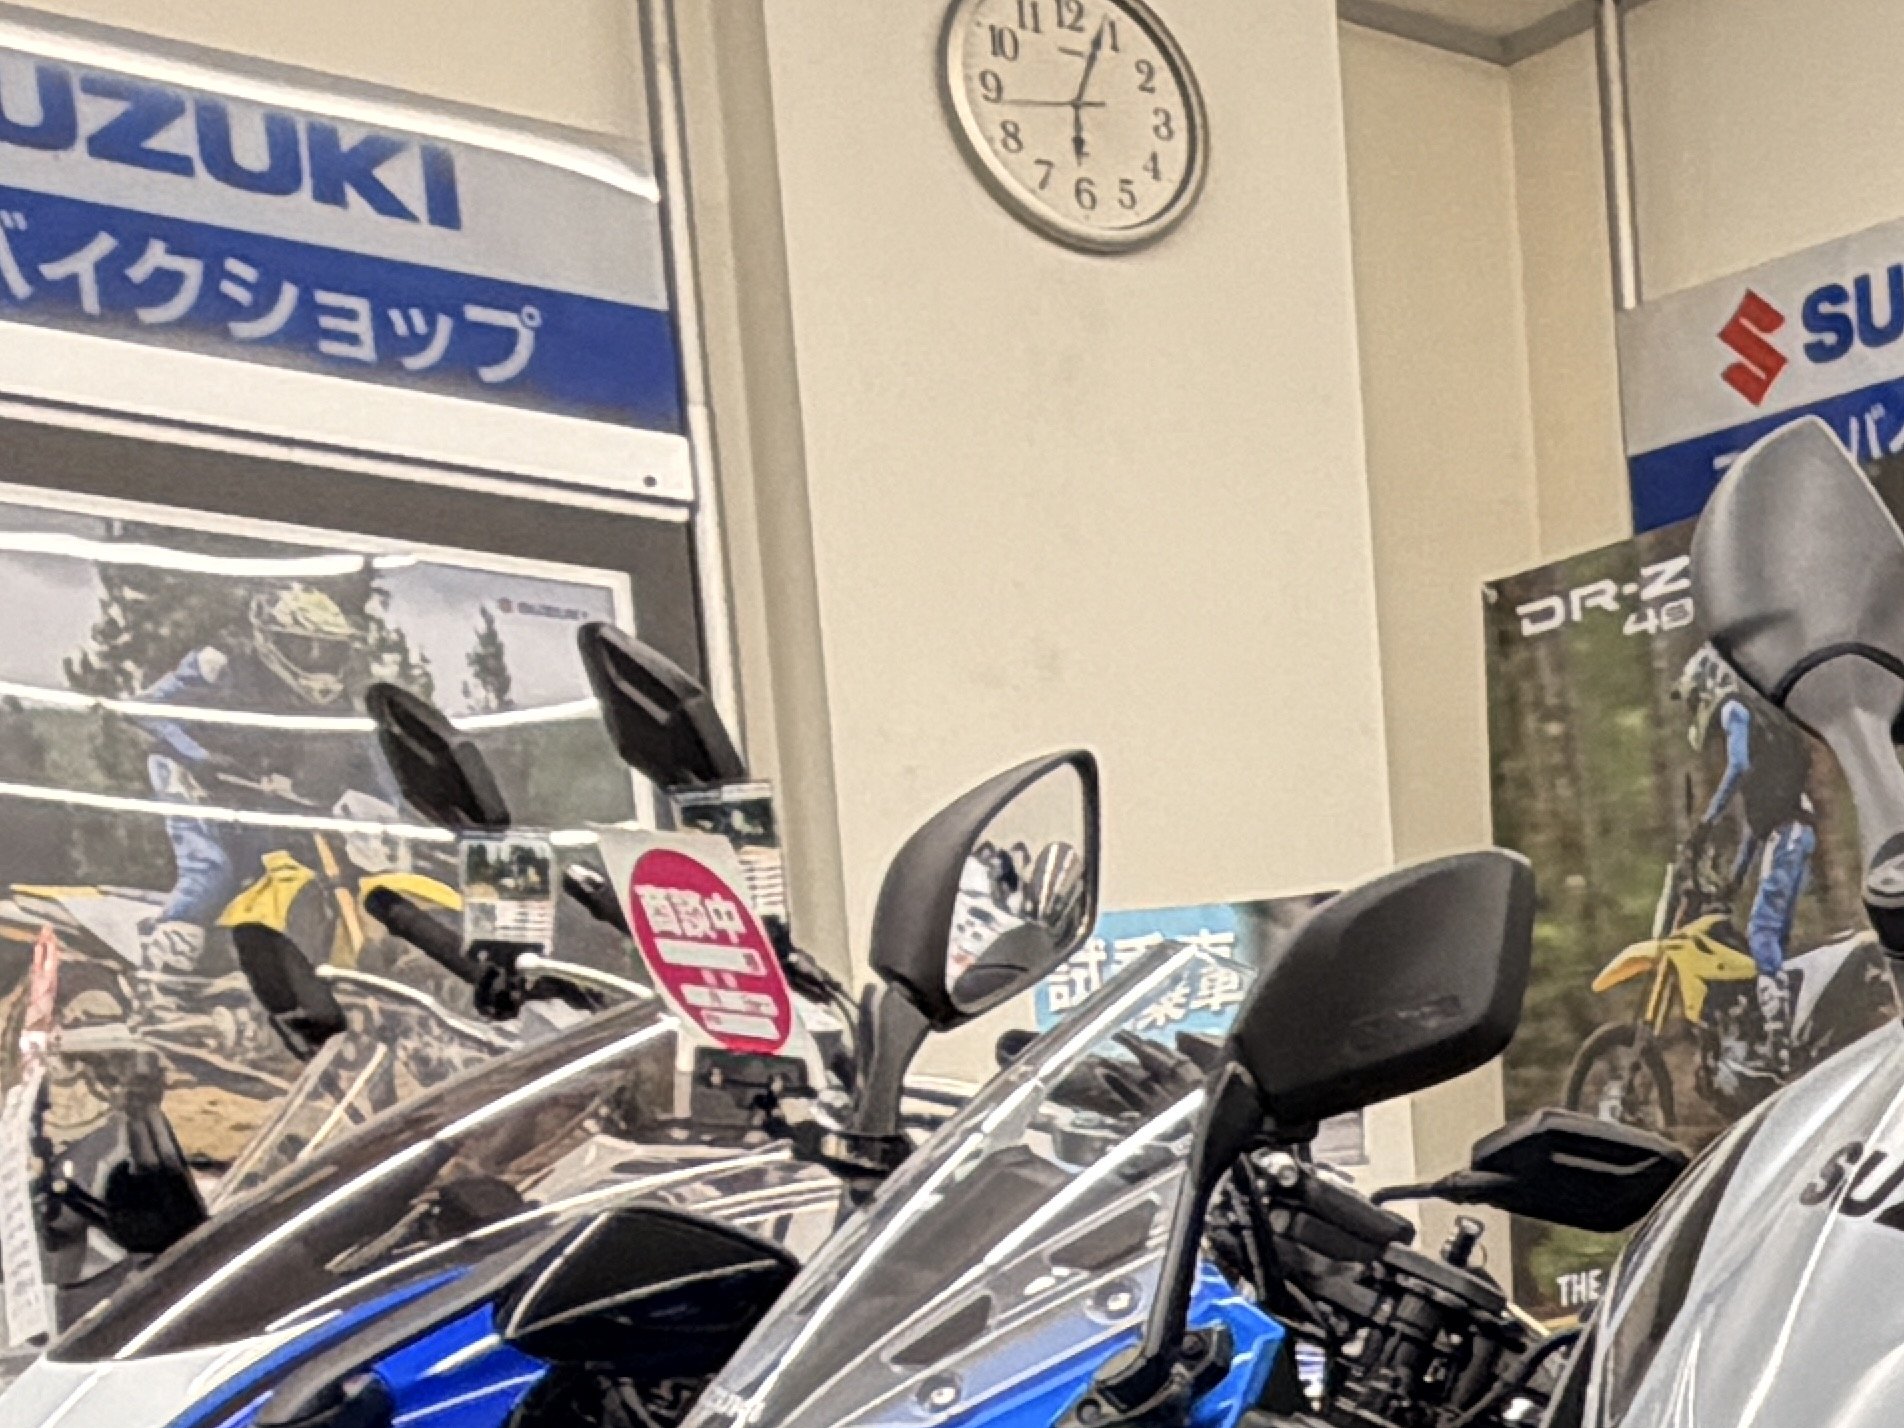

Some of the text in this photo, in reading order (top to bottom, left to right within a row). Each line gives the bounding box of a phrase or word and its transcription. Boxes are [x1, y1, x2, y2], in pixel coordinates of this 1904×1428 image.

[988, 23, 1019, 62] 10
[979, 69, 1003, 103] 9
[1134, 59, 1156, 94] 2
[1000, 119, 1024, 153] 8
[1151, 107, 1175, 142] 3
[1033, 158, 1054, 191] 7
[1142, 150, 1162, 182] 4
[1074, 176, 1098, 211] 6
[1117, 178, 1138, 210] 5
[1556, 1268, 1602, 1307] THE
